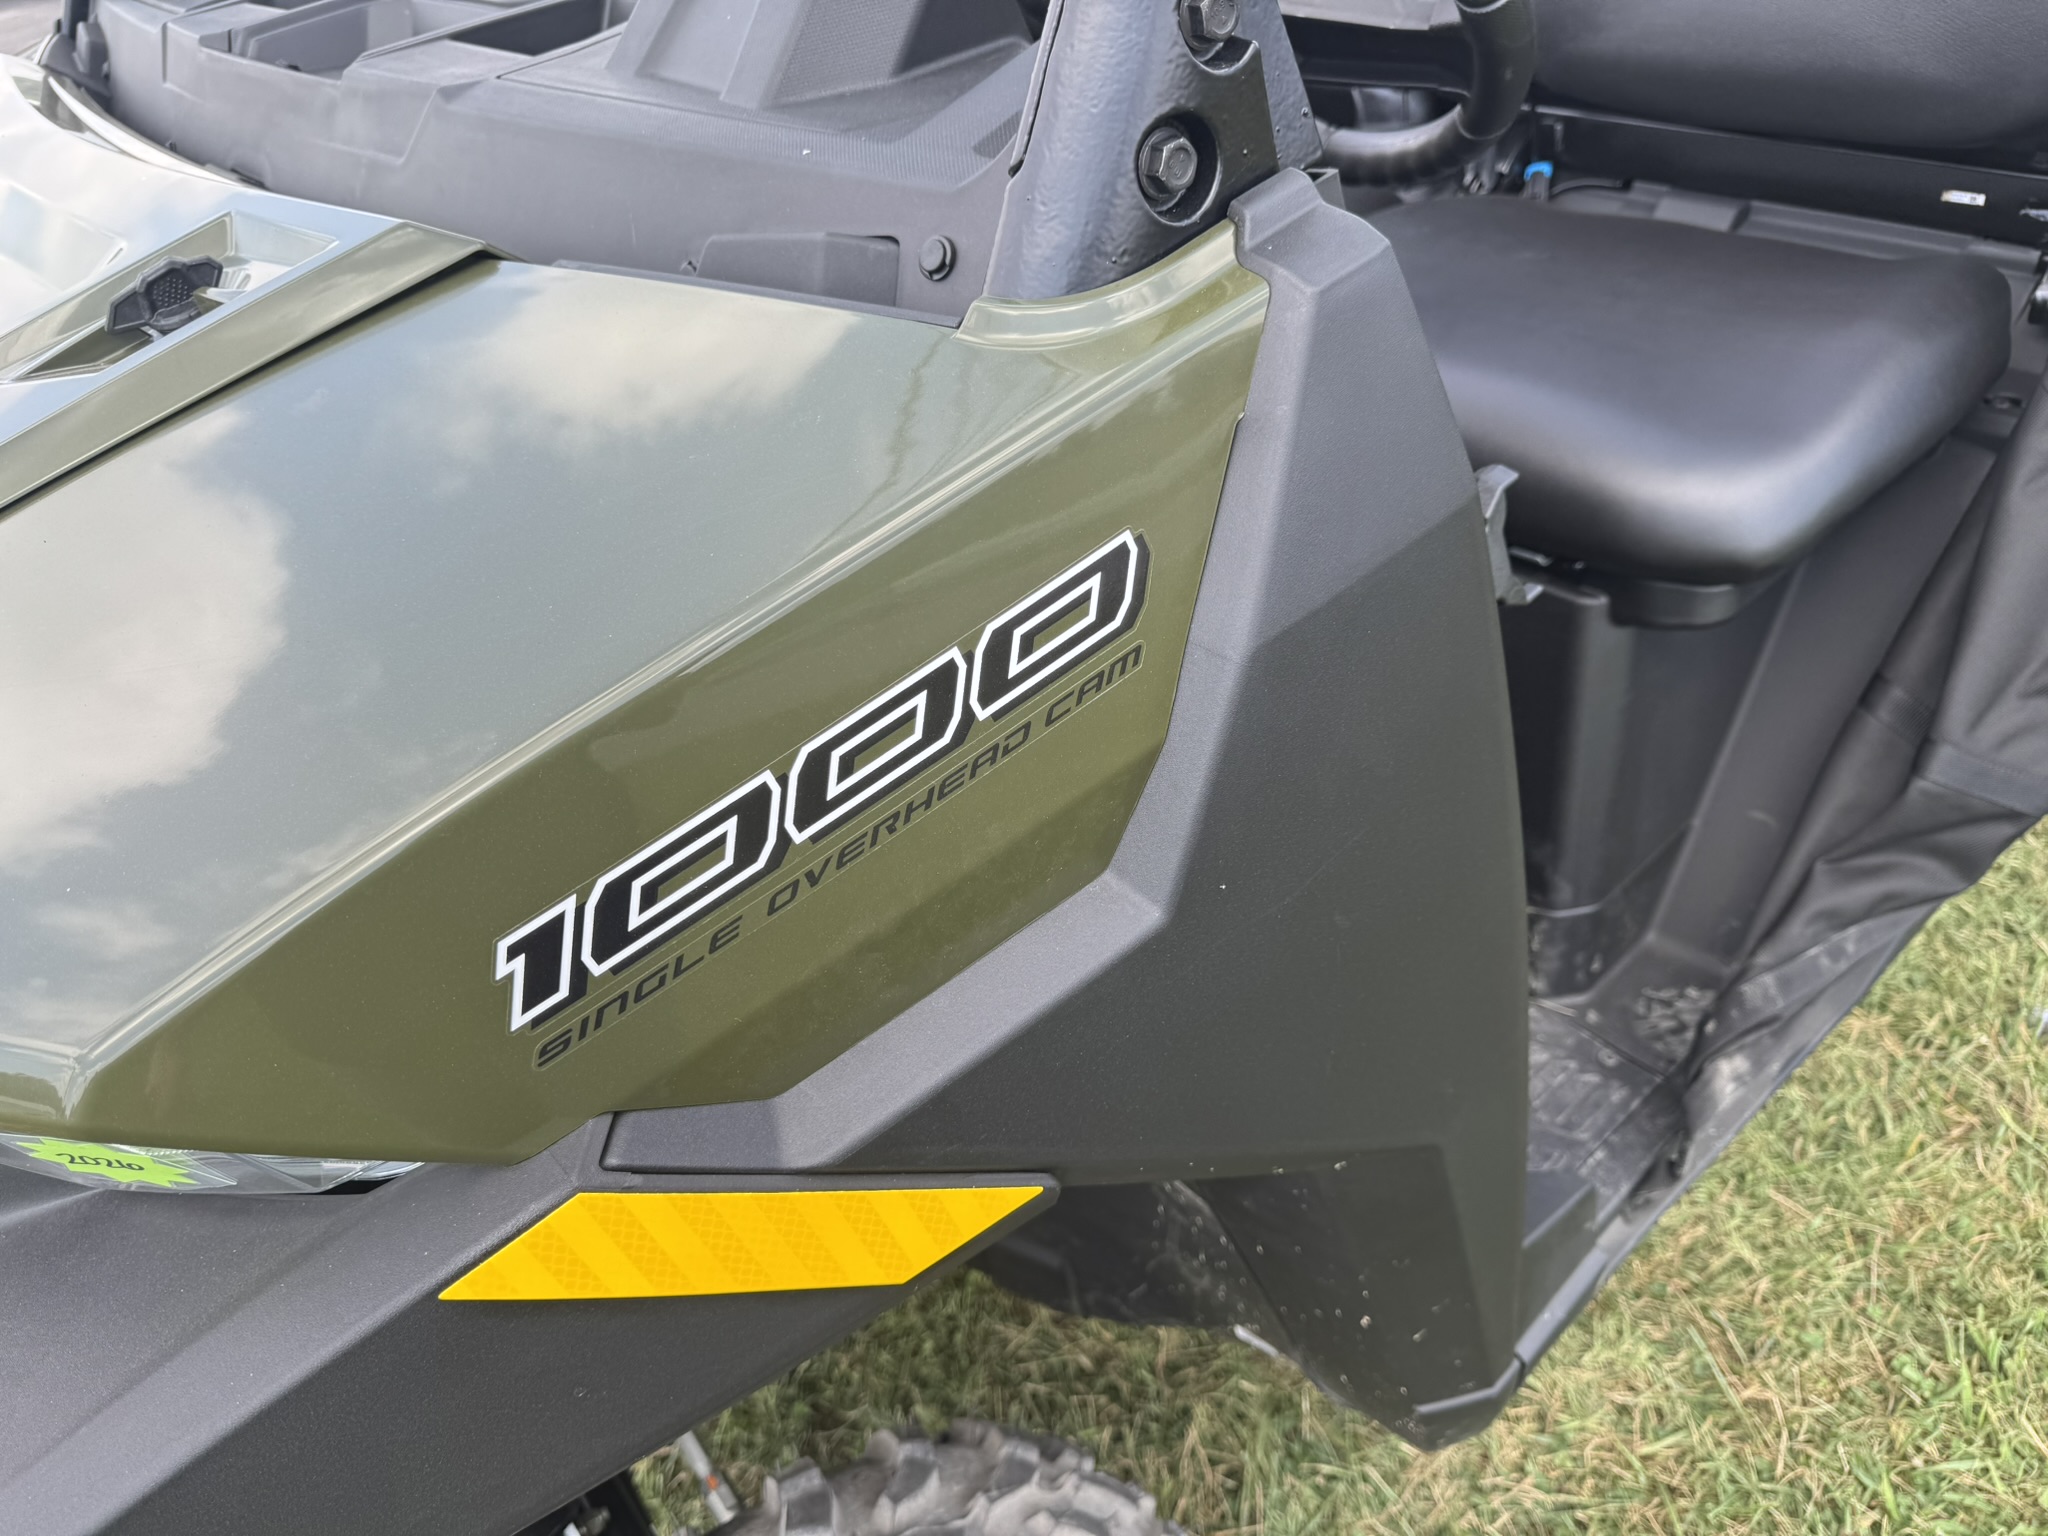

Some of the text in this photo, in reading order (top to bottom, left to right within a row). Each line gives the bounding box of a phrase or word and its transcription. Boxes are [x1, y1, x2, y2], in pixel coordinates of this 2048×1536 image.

[495, 529, 1150, 1032] 1000
[537, 644, 1142, 1068] SINGLE OVERHEAD CAM
[55, 1152, 145, 1171] 2026
